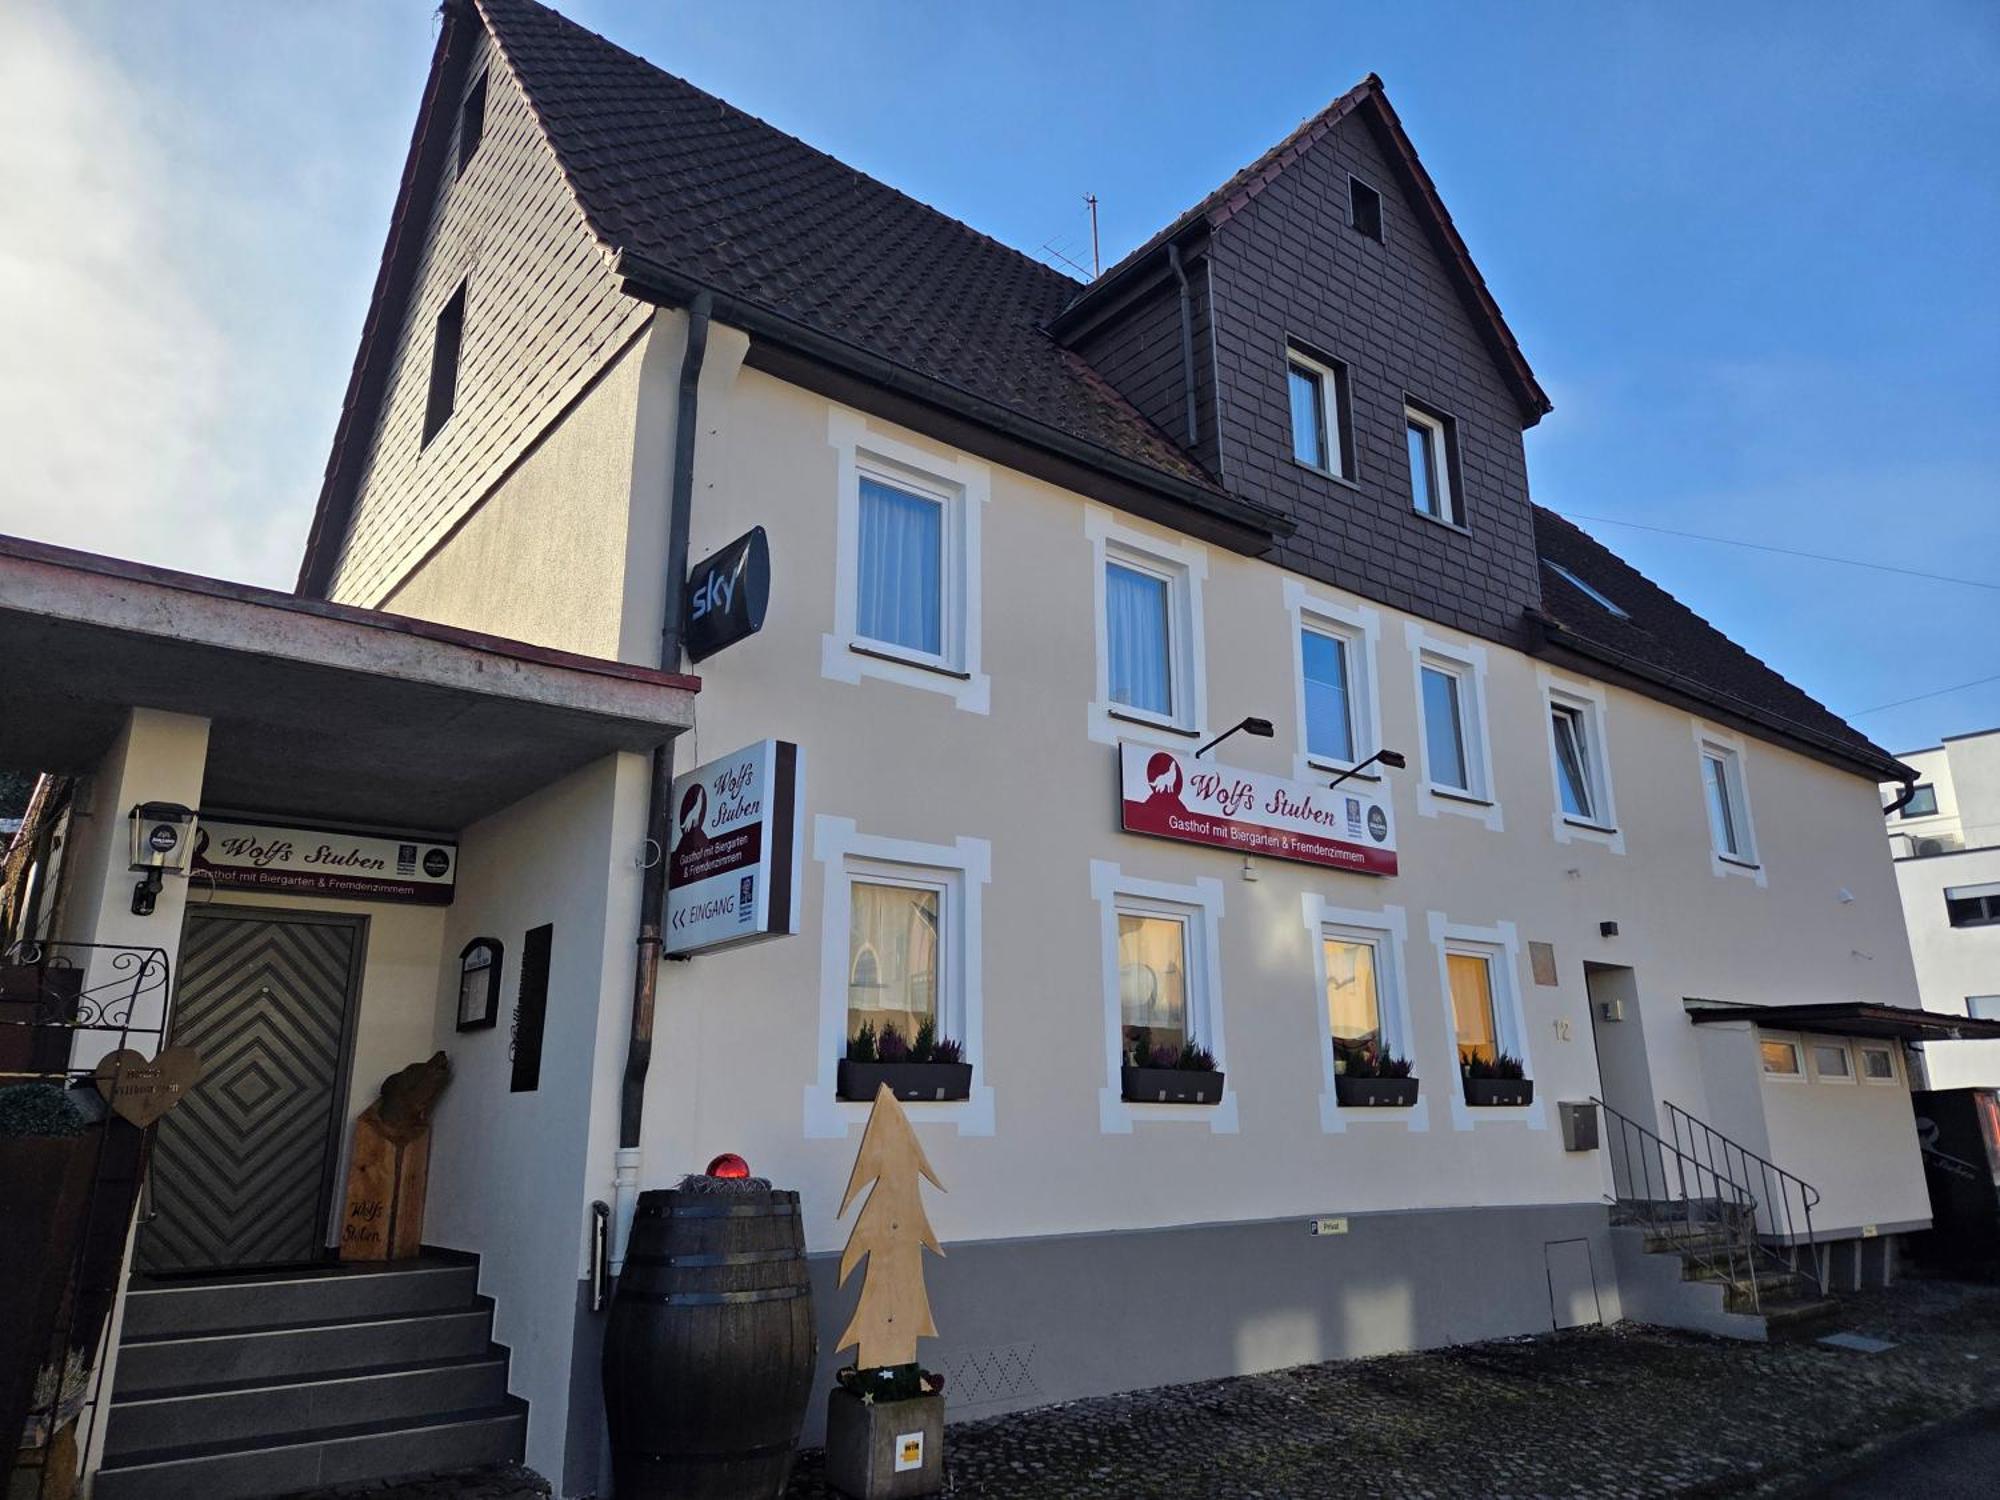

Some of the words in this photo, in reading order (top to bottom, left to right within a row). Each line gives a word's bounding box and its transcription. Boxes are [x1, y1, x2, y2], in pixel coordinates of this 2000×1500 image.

[691, 565, 740, 621] sky
[713, 762, 754, 800] Wolfs
[711, 797, 760, 828] Stuben
[1190, 771, 1253, 817] Wolfs
[1265, 788, 1336, 827] Stuben
[221, 834, 294, 866] Wolfs
[303, 844, 385, 871] Stuben
[680, 849, 703, 866] Gasthof
[703, 846, 715, 857] mit
[714, 835, 749, 854] Biergarten
[1168, 815, 1210, 835] Gasthof
[1212, 823, 1228, 839] mit
[1230, 827, 1280, 849] Biergarten
[1282, 836, 1289, 849] &
[1291, 838, 1365, 864] Fremdenzimmern
[239, 872, 259, 882] mit
[259, 872, 315, 887] Biergarten
[318, 878, 326, 888] &
[328, 879, 414, 895] Fremdenzimmern
[689, 895, 735, 923] EINGANG
[1553, 1018, 1571, 1042] 12
[342, 1223, 380, 1242] Stuben
